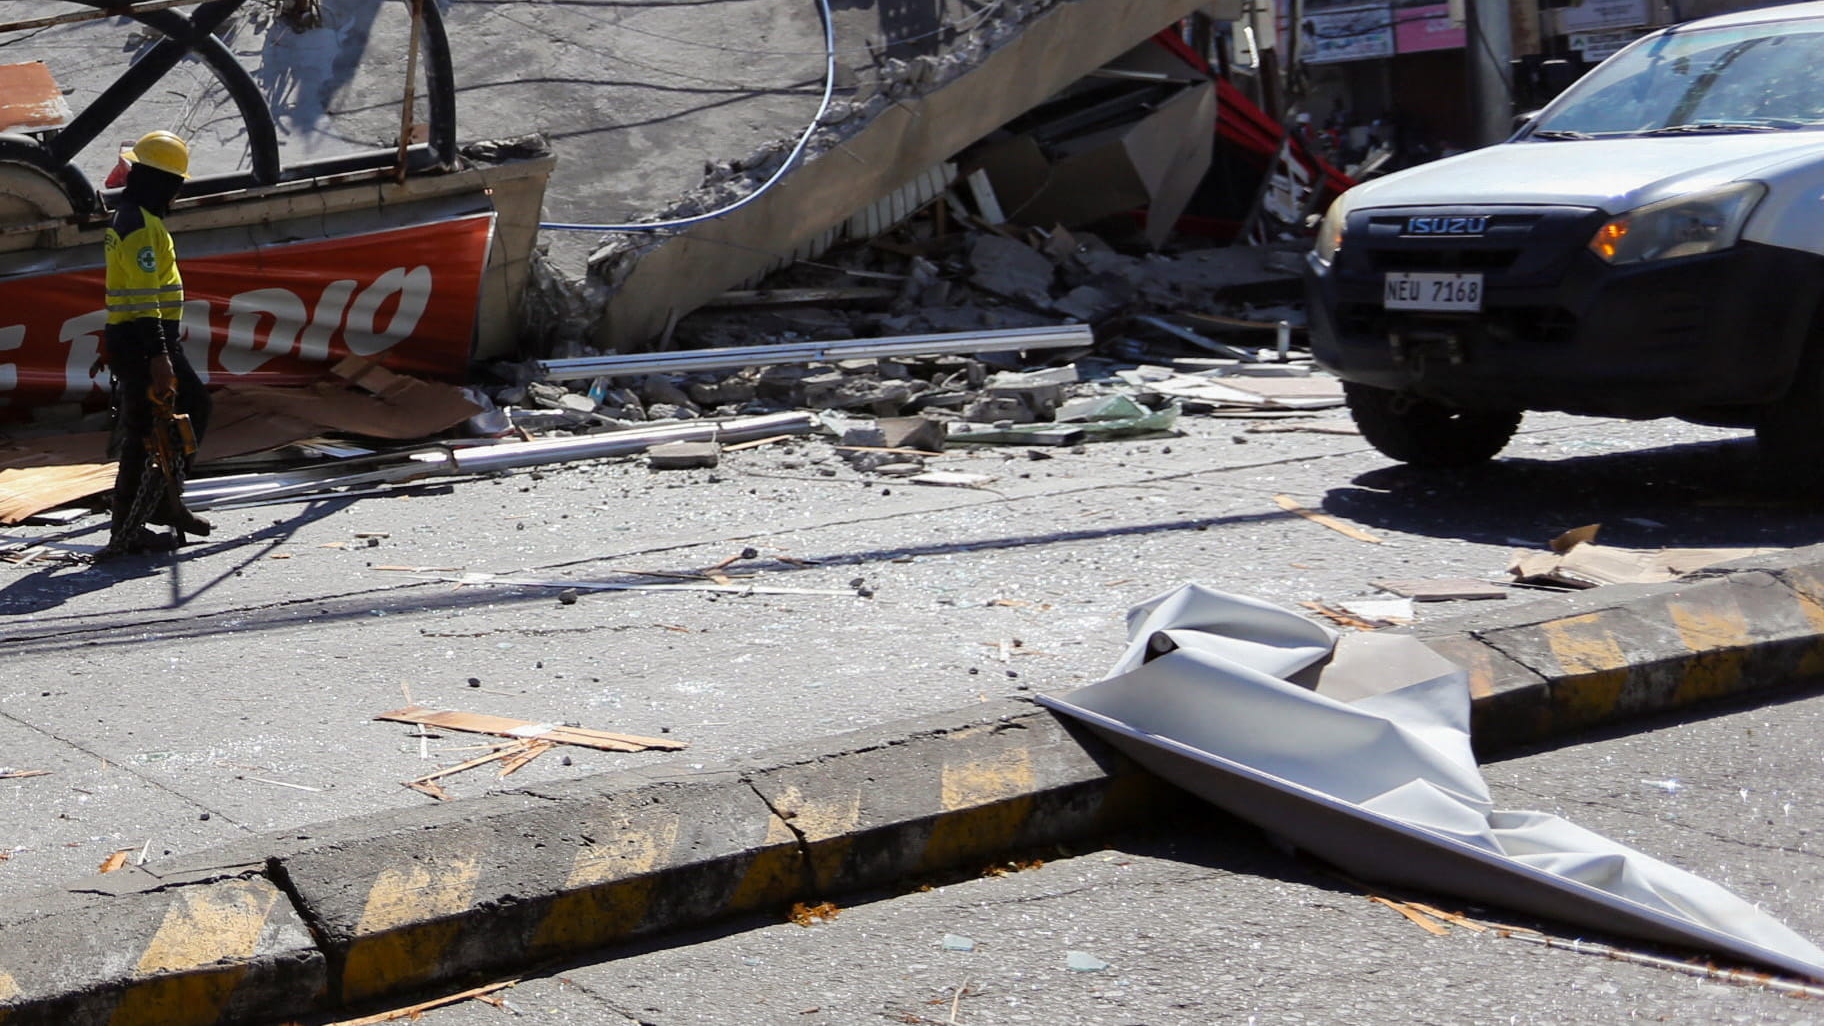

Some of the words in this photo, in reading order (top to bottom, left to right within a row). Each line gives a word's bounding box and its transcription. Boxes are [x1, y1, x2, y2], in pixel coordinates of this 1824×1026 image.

[1407, 217, 1487, 234] ISUZU
[1386, 280, 1421, 302] NEU
[1431, 280, 1479, 303] 7168
